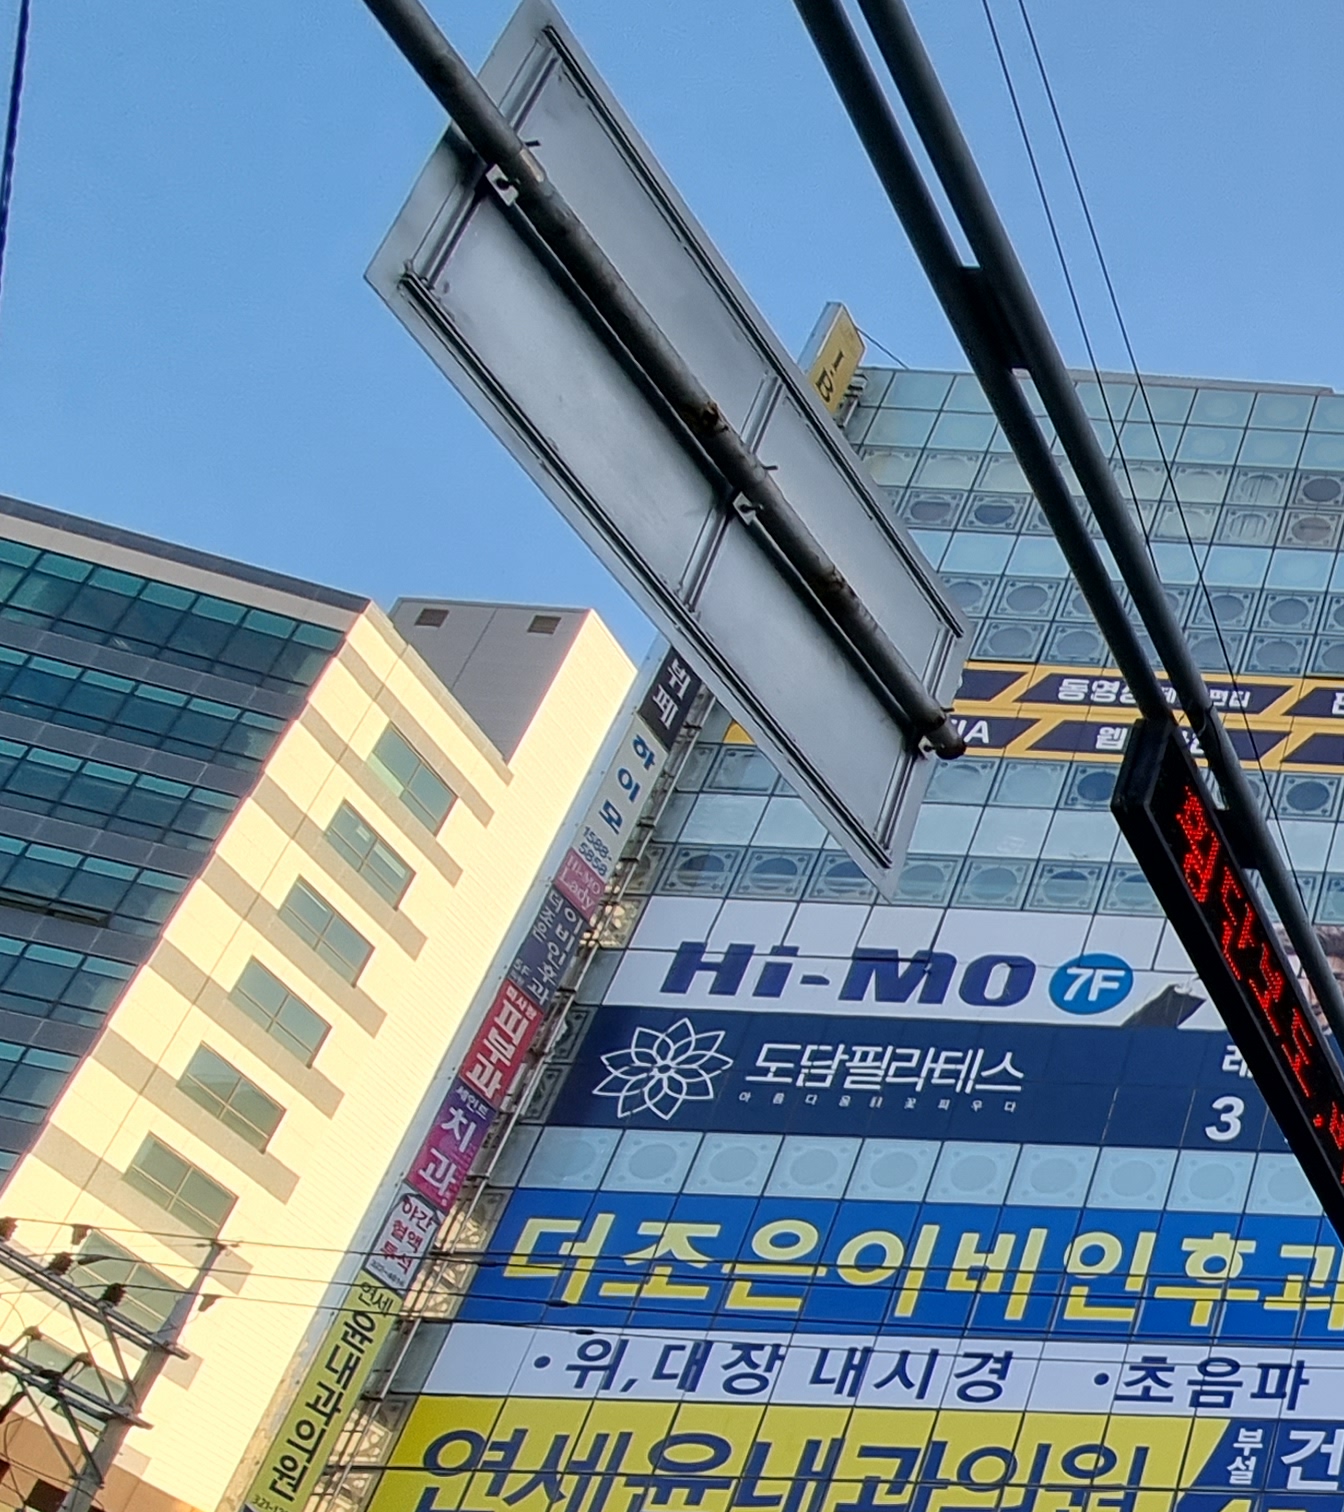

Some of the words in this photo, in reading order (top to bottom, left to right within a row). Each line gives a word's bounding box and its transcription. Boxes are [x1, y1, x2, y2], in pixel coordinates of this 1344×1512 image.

[652, 658, 692, 729] 뷔페
[598, 732, 657, 836] 하이모
[658, 940, 1038, 1007] Hi-MO
[1063, 966, 1129, 1002] 7F
[467, 997, 533, 1098] 피부과
[746, 1043, 1026, 1095] 도담필라테스
[417, 1104, 476, 1211] 치과
[808, 1344, 1015, 1401] 내시경
[1115, 1353, 1309, 1412] 초음파
